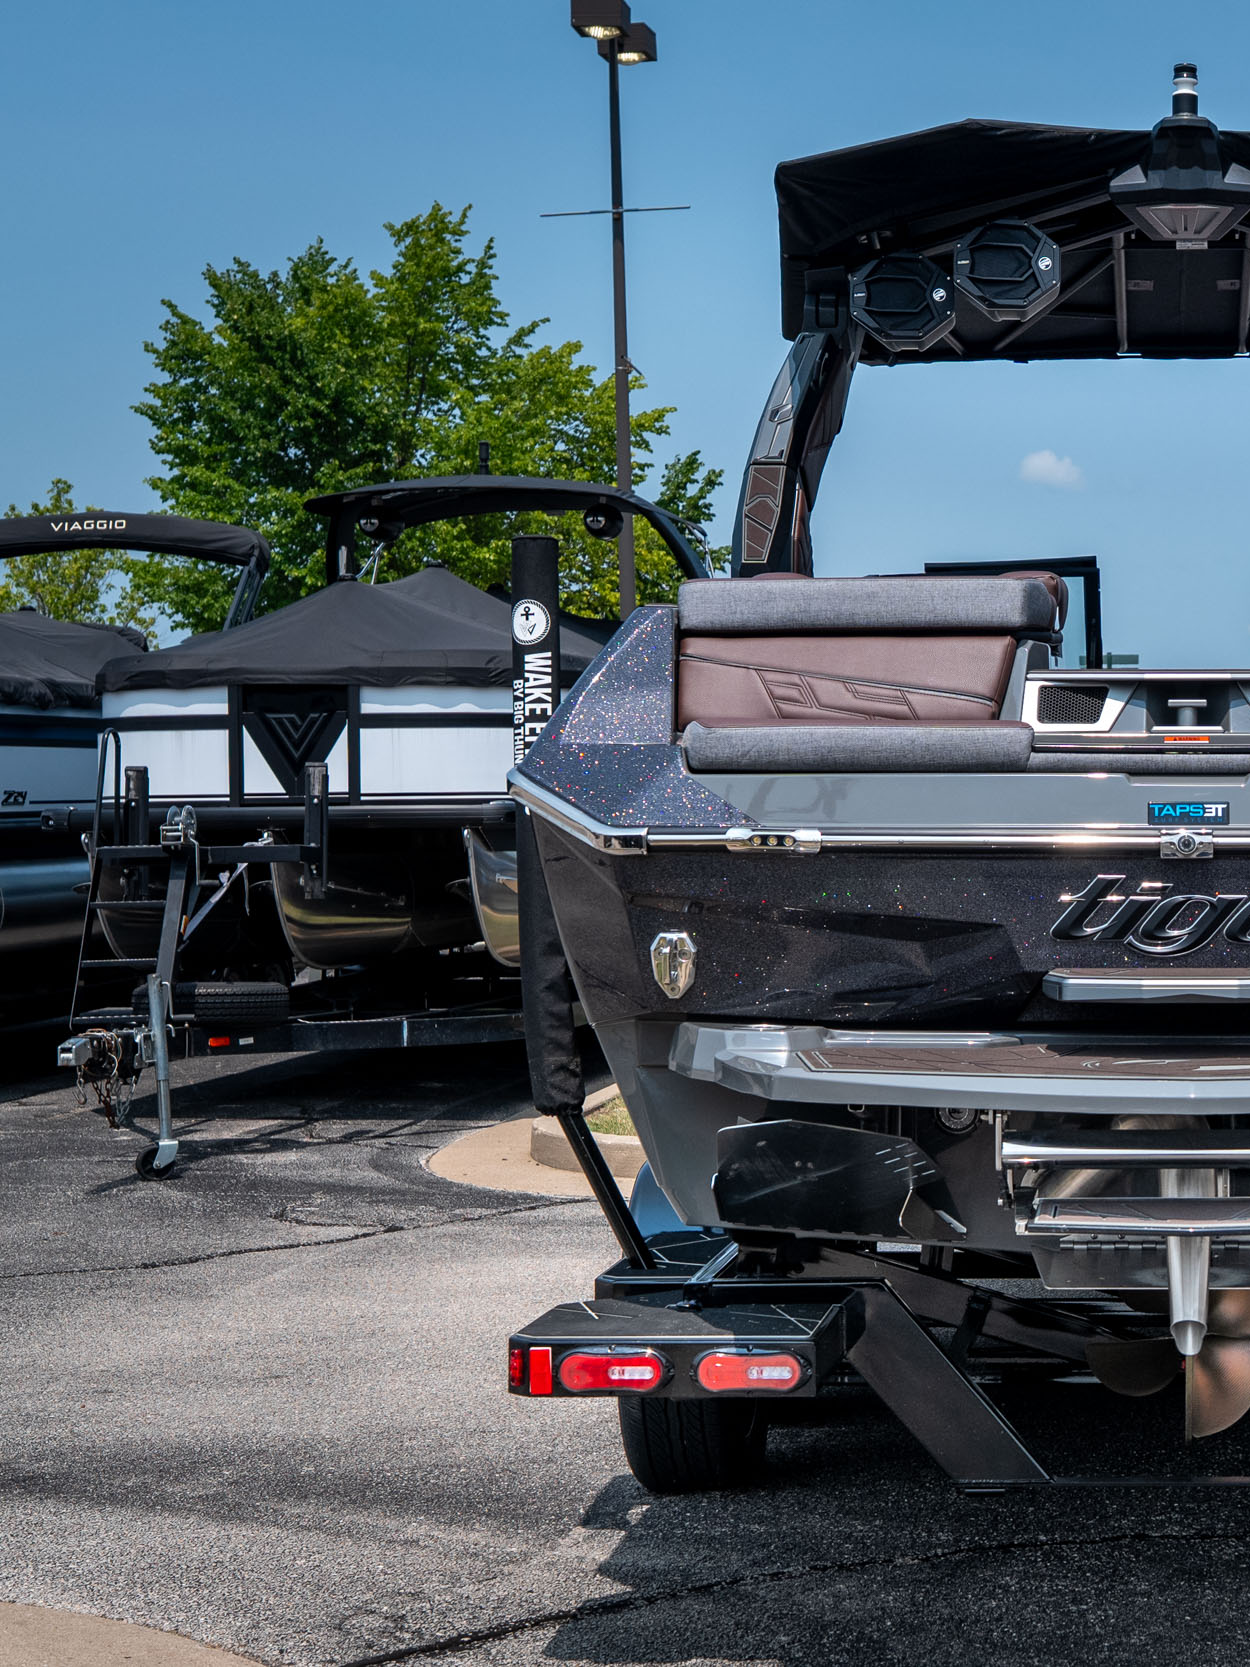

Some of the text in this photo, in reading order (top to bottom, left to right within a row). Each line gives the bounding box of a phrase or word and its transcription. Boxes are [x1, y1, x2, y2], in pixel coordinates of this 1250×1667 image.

[50, 519, 127, 532] VIAGGIO
[513, 680, 524, 697] BY
[524, 651, 552, 716] WAKE
[513, 701, 524, 724] BIG
